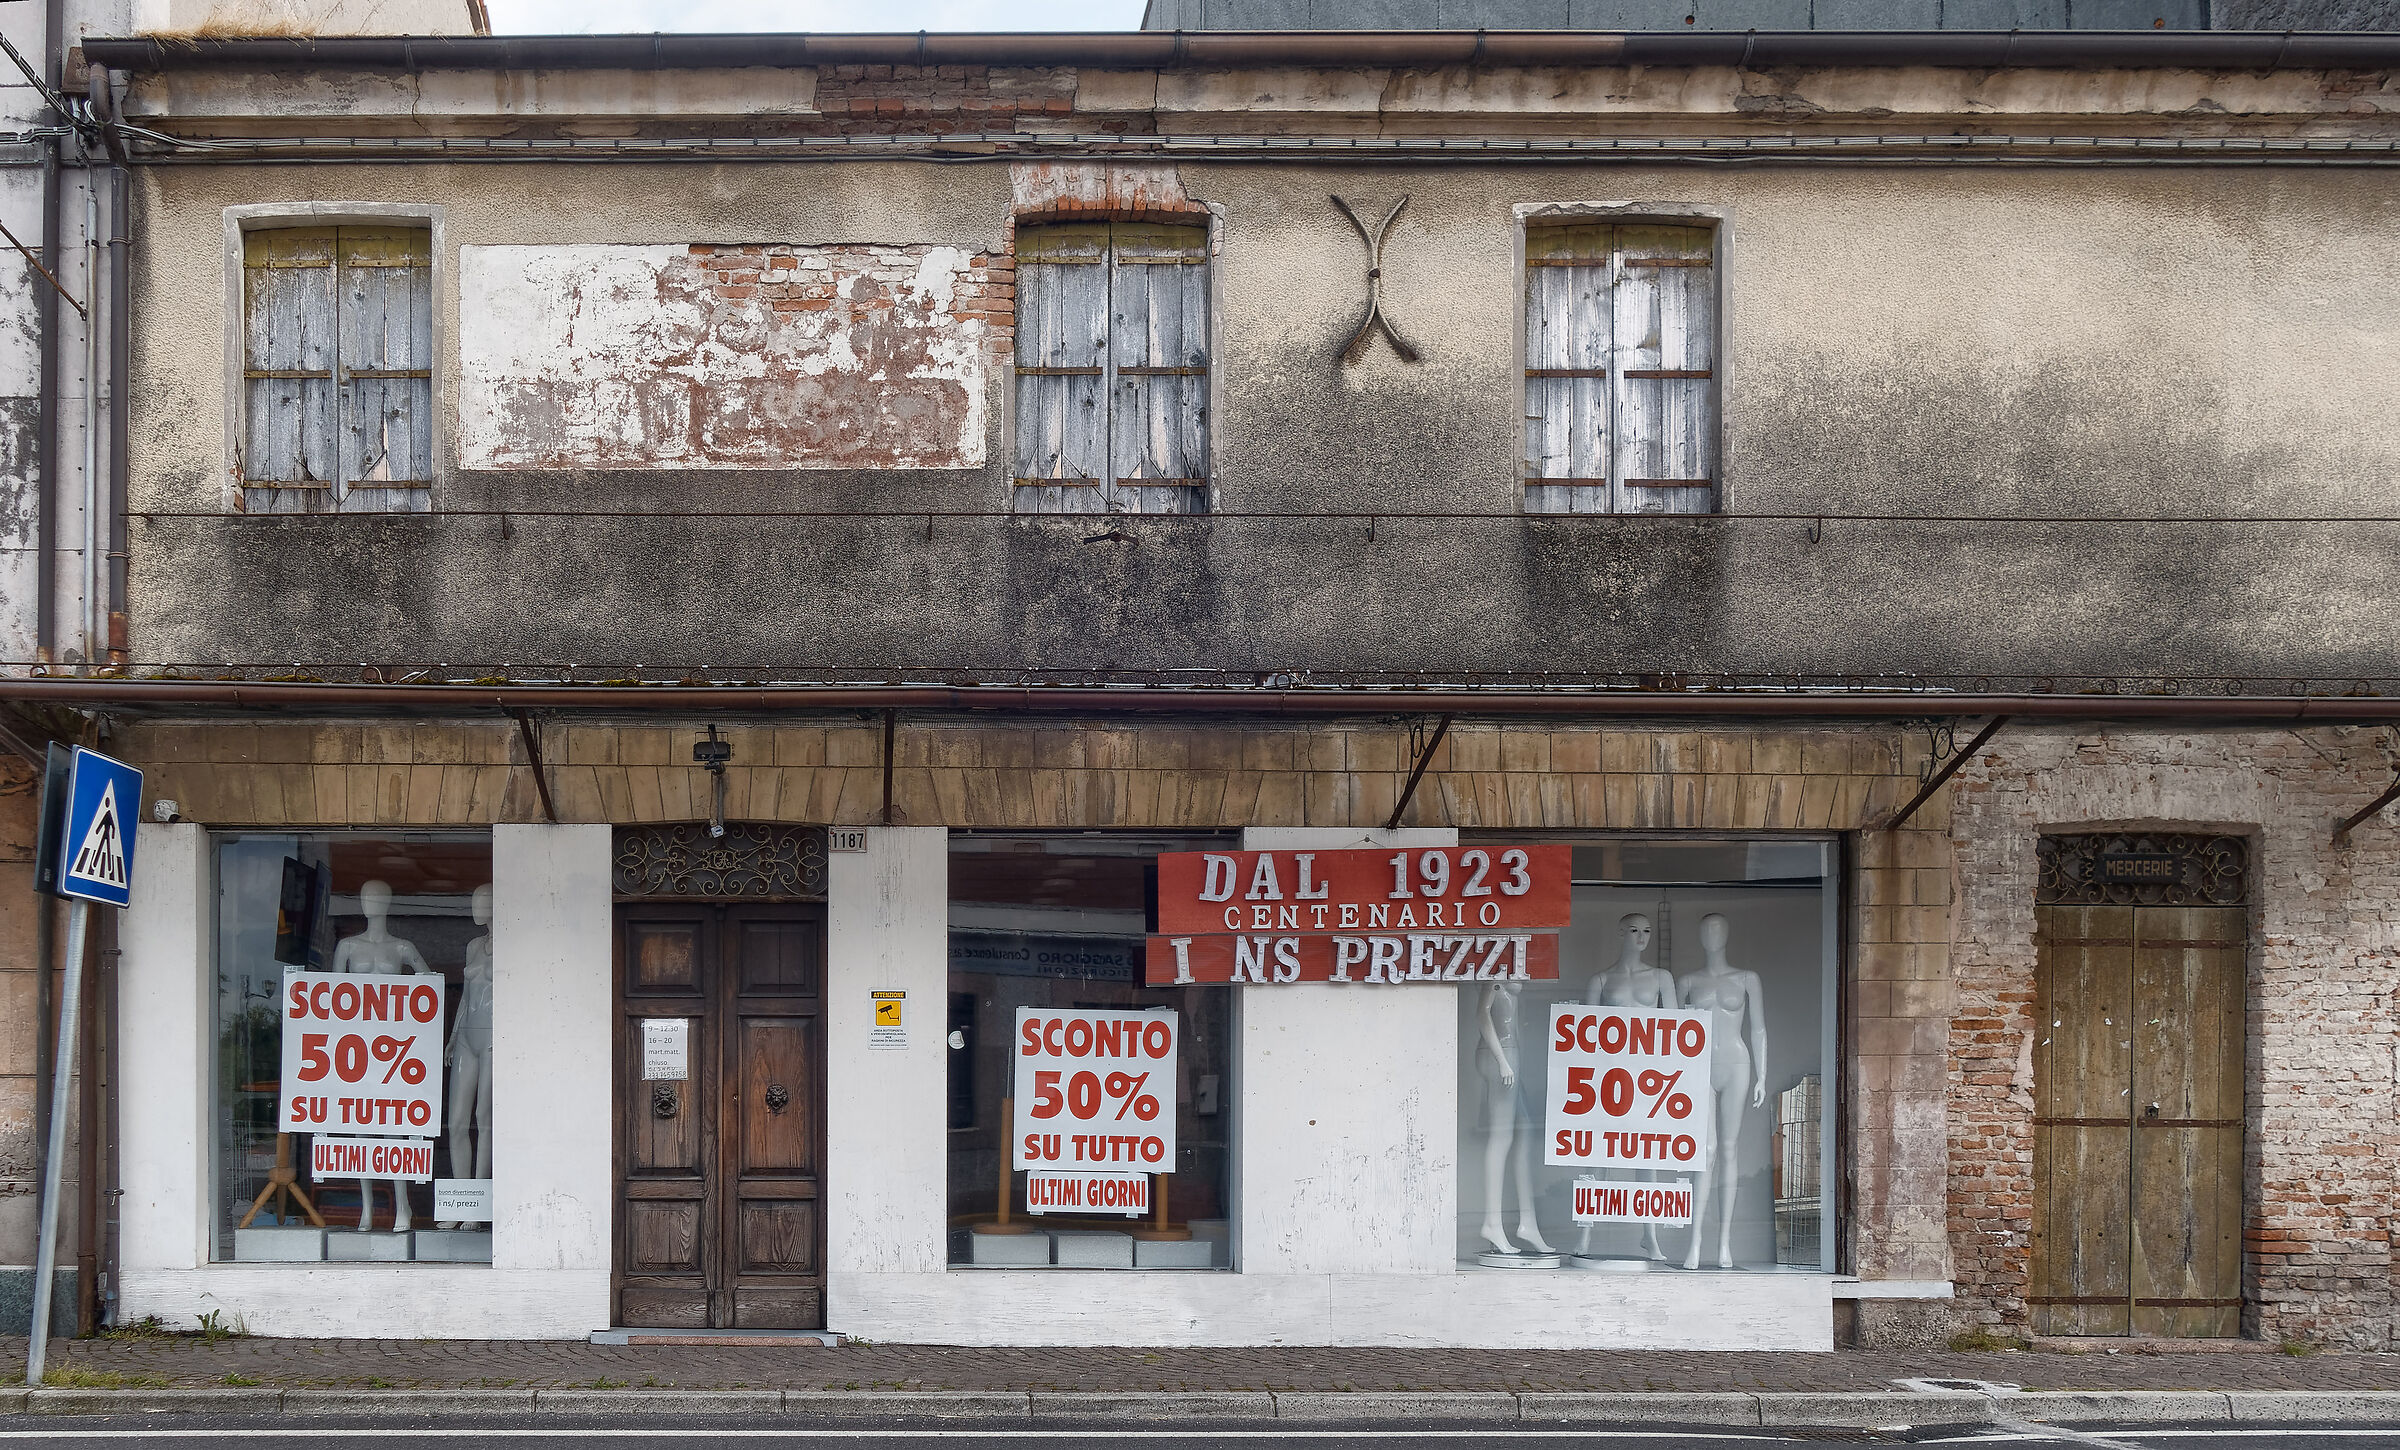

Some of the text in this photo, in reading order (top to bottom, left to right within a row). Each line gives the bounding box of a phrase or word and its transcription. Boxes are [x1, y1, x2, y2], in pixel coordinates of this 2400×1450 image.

[832, 832, 864, 849] 1187
[1198, 849, 1532, 902] DAL 1923
[2105, 860, 2174, 877] MERCERIE
[1224, 901, 1501, 930] CENTENARIO
[1170, 934, 1532, 985] I NS PREZZI
[289, 981, 439, 1023] SCONTO
[1022, 1018, 1172, 1059] SCONTO
[1555, 1014, 1706, 1058] SCONTO
[297, 1033, 427, 1085] 50%
[1030, 1070, 1160, 1122] 50%
[1563, 1066, 1693, 1120] 50%
[291, 1096, 431, 1127] SU TUTTO
[315, 1145, 431, 1175] ULTIMI GIORNI
[1024, 1133, 1165, 1163] SU TUTTO
[1556, 1129, 1696, 1161] SU TUTTO
[456, 1199, 479, 1208] prezzi
[1029, 1178, 1146, 1208] ULTIMI GIORNI
[1575, 1188, 1691, 1219] ULTIMI GIORNI
